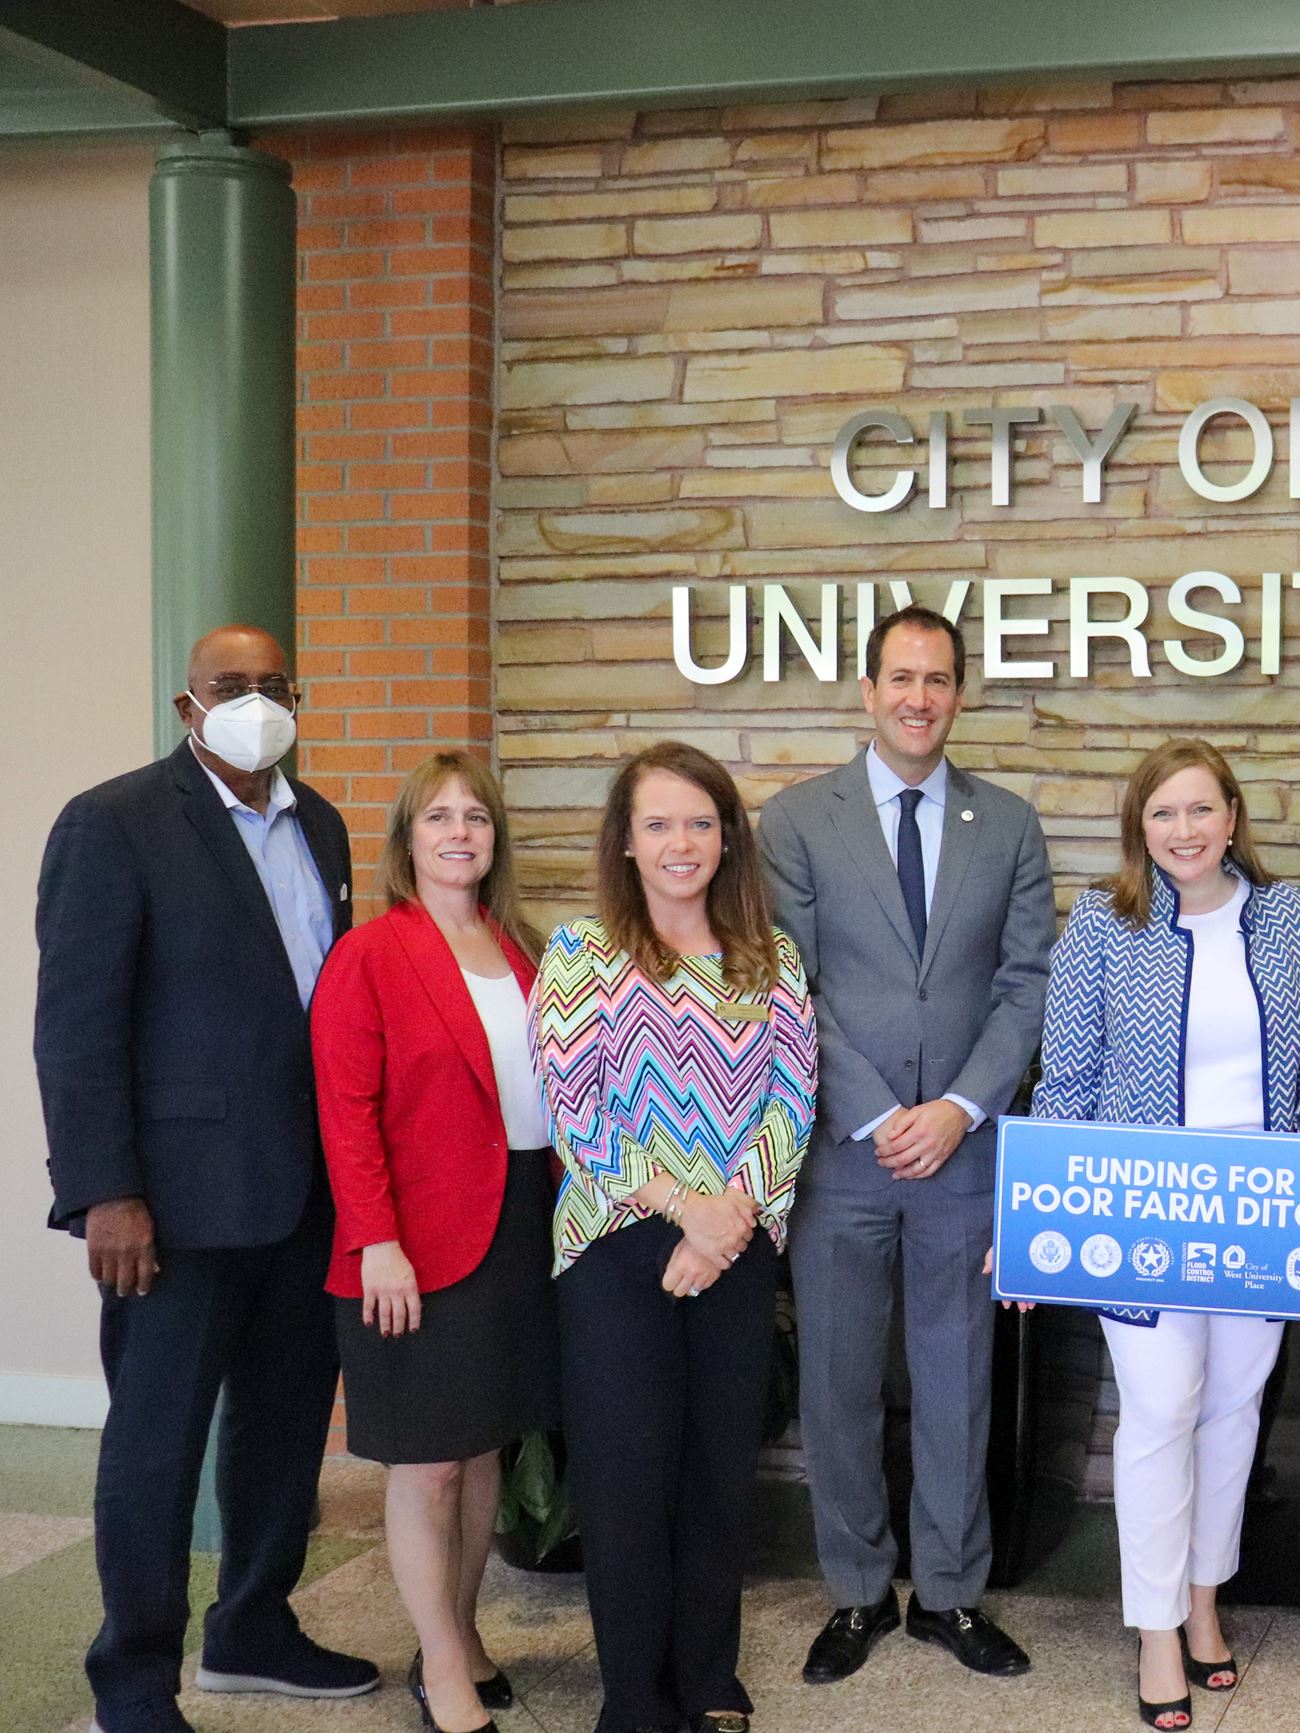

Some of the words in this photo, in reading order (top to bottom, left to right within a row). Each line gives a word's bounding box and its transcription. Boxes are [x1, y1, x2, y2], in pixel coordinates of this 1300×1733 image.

[830, 402, 1137, 512] CITY
[1067, 1155, 1218, 1190] FUNDING
[1228, 1165, 1296, 1196] FOR
[1011, 1182, 1114, 1217] POOR
[1124, 1190, 1226, 1225] FARM
[1186, 1261, 1207, 1269] FLOOD
[1245, 1262, 1260, 1272] City
[1260, 1263, 1269, 1271] of
[1186, 1268, 1214, 1276] CONTROL
[1223, 1270, 1242, 1279] West
[1244, 1271, 1284, 1284] University
[1186, 1275, 1215, 1283] DISTRICT
[1244, 1280, 1265, 1290] Place
